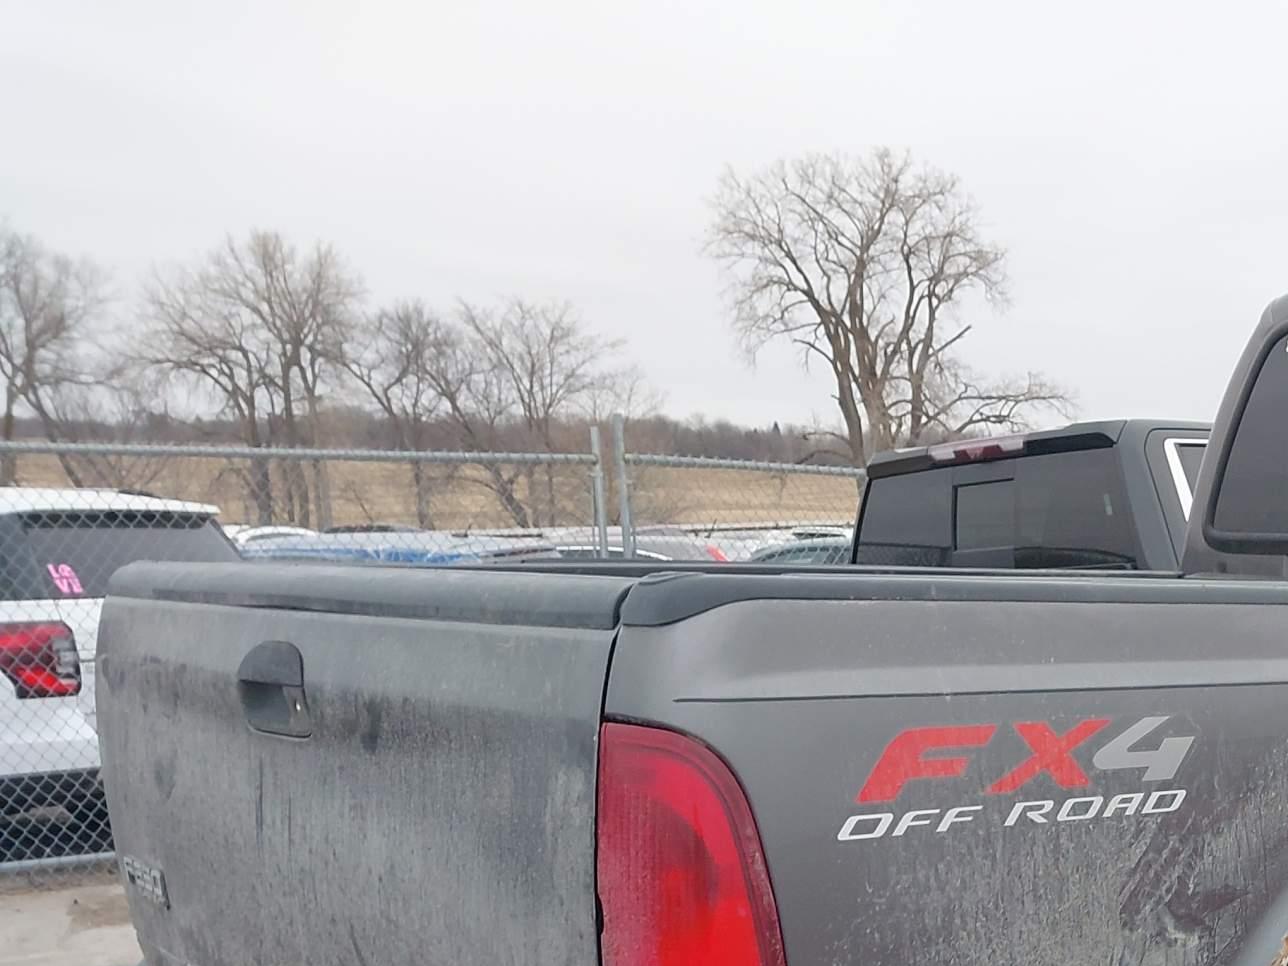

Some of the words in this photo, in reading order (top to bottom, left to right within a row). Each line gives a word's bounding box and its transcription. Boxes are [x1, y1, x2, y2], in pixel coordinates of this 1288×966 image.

[854, 715, 1195, 804] FX4
[836, 805, 983, 841] OFF
[1003, 789, 1188, 827] ROAD
